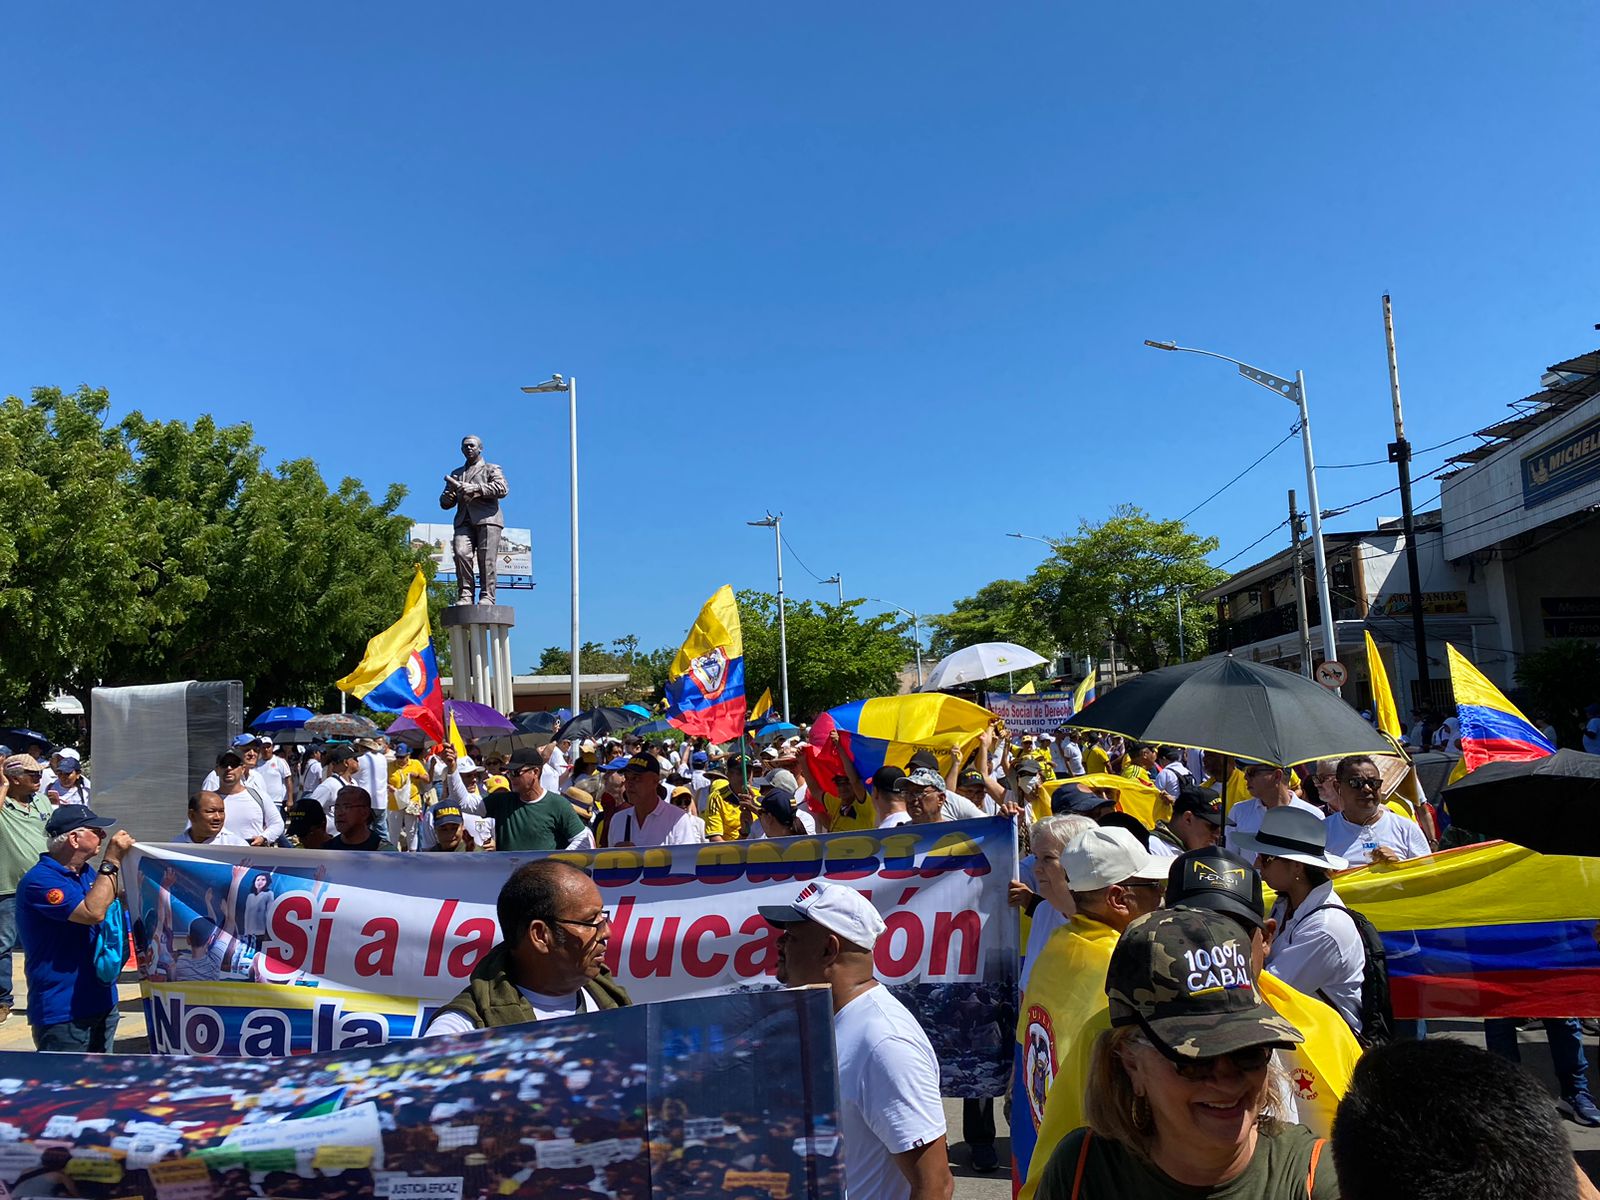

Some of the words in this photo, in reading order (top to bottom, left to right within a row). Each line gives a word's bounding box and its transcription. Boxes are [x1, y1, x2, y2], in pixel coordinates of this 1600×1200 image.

[1011, 704, 1033, 718] Social
[1034, 704, 1043, 718] de
[1044, 704, 1073, 718] Derecho
[265, 896, 341, 975] Si
[354, 916, 400, 977] a
[423, 898, 496, 978] la
[1184, 943, 1246, 972] 100%
[1187, 967, 1250, 992] CABAL
[153, 995, 220, 1056] No
[244, 1016, 286, 1057] a
